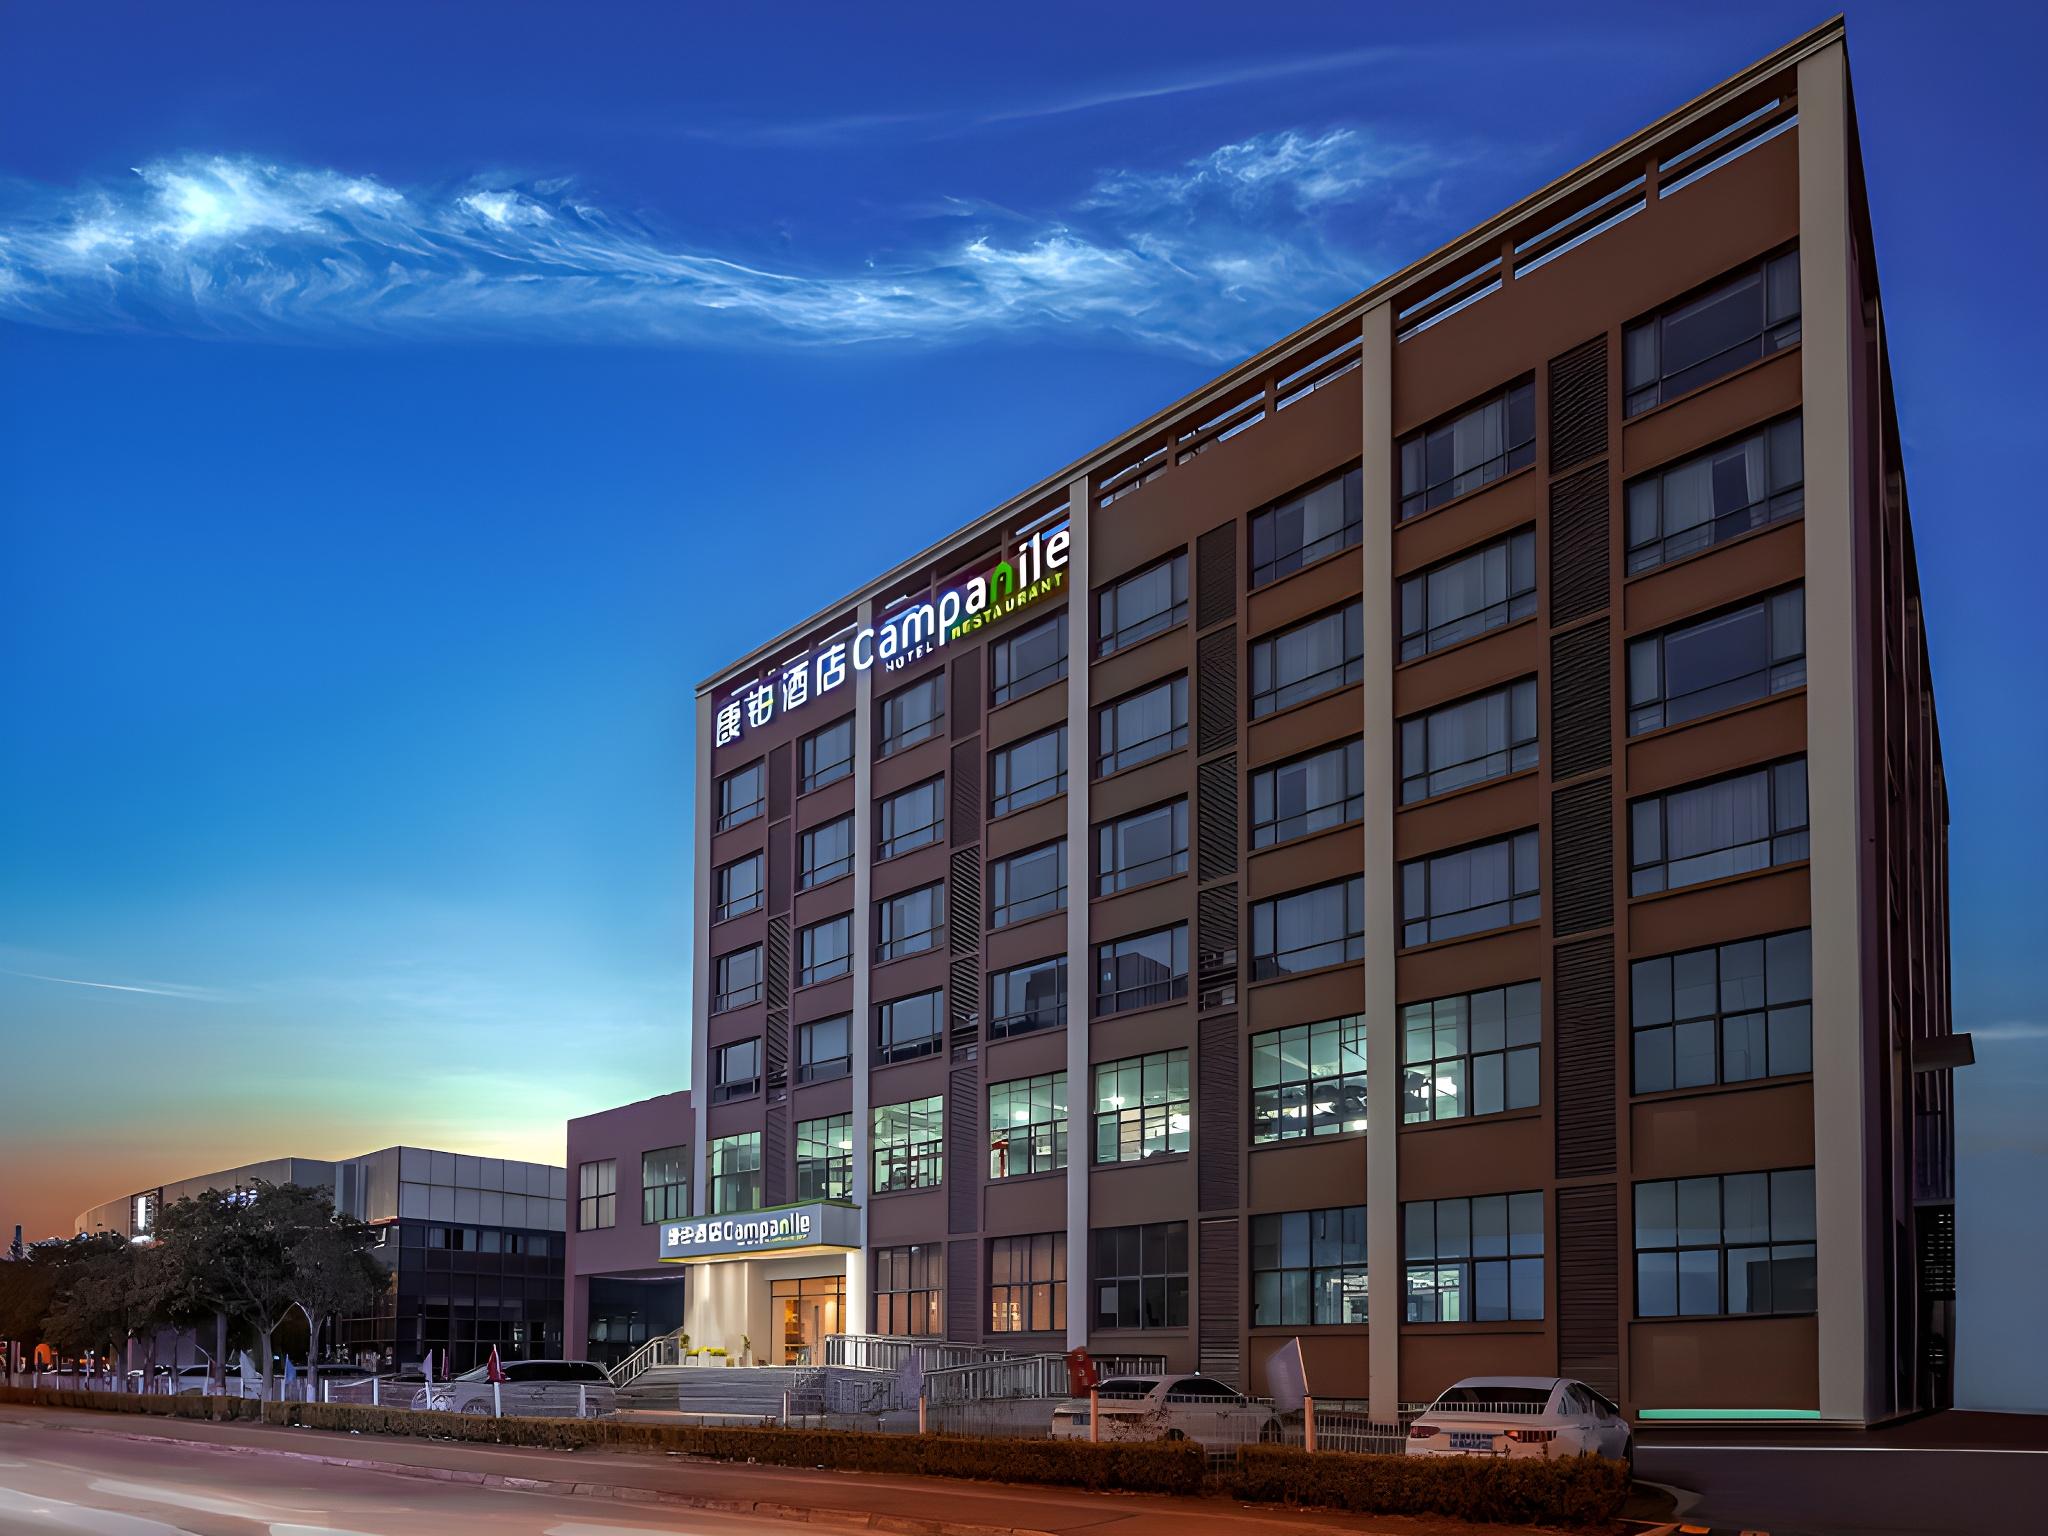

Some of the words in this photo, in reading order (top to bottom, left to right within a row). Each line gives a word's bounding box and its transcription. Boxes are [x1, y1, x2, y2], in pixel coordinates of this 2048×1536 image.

[853, 530, 1070, 670] Campanile
[951, 572, 1063, 640] RESTAURANT
[885, 641, 934, 673] HOTEL
